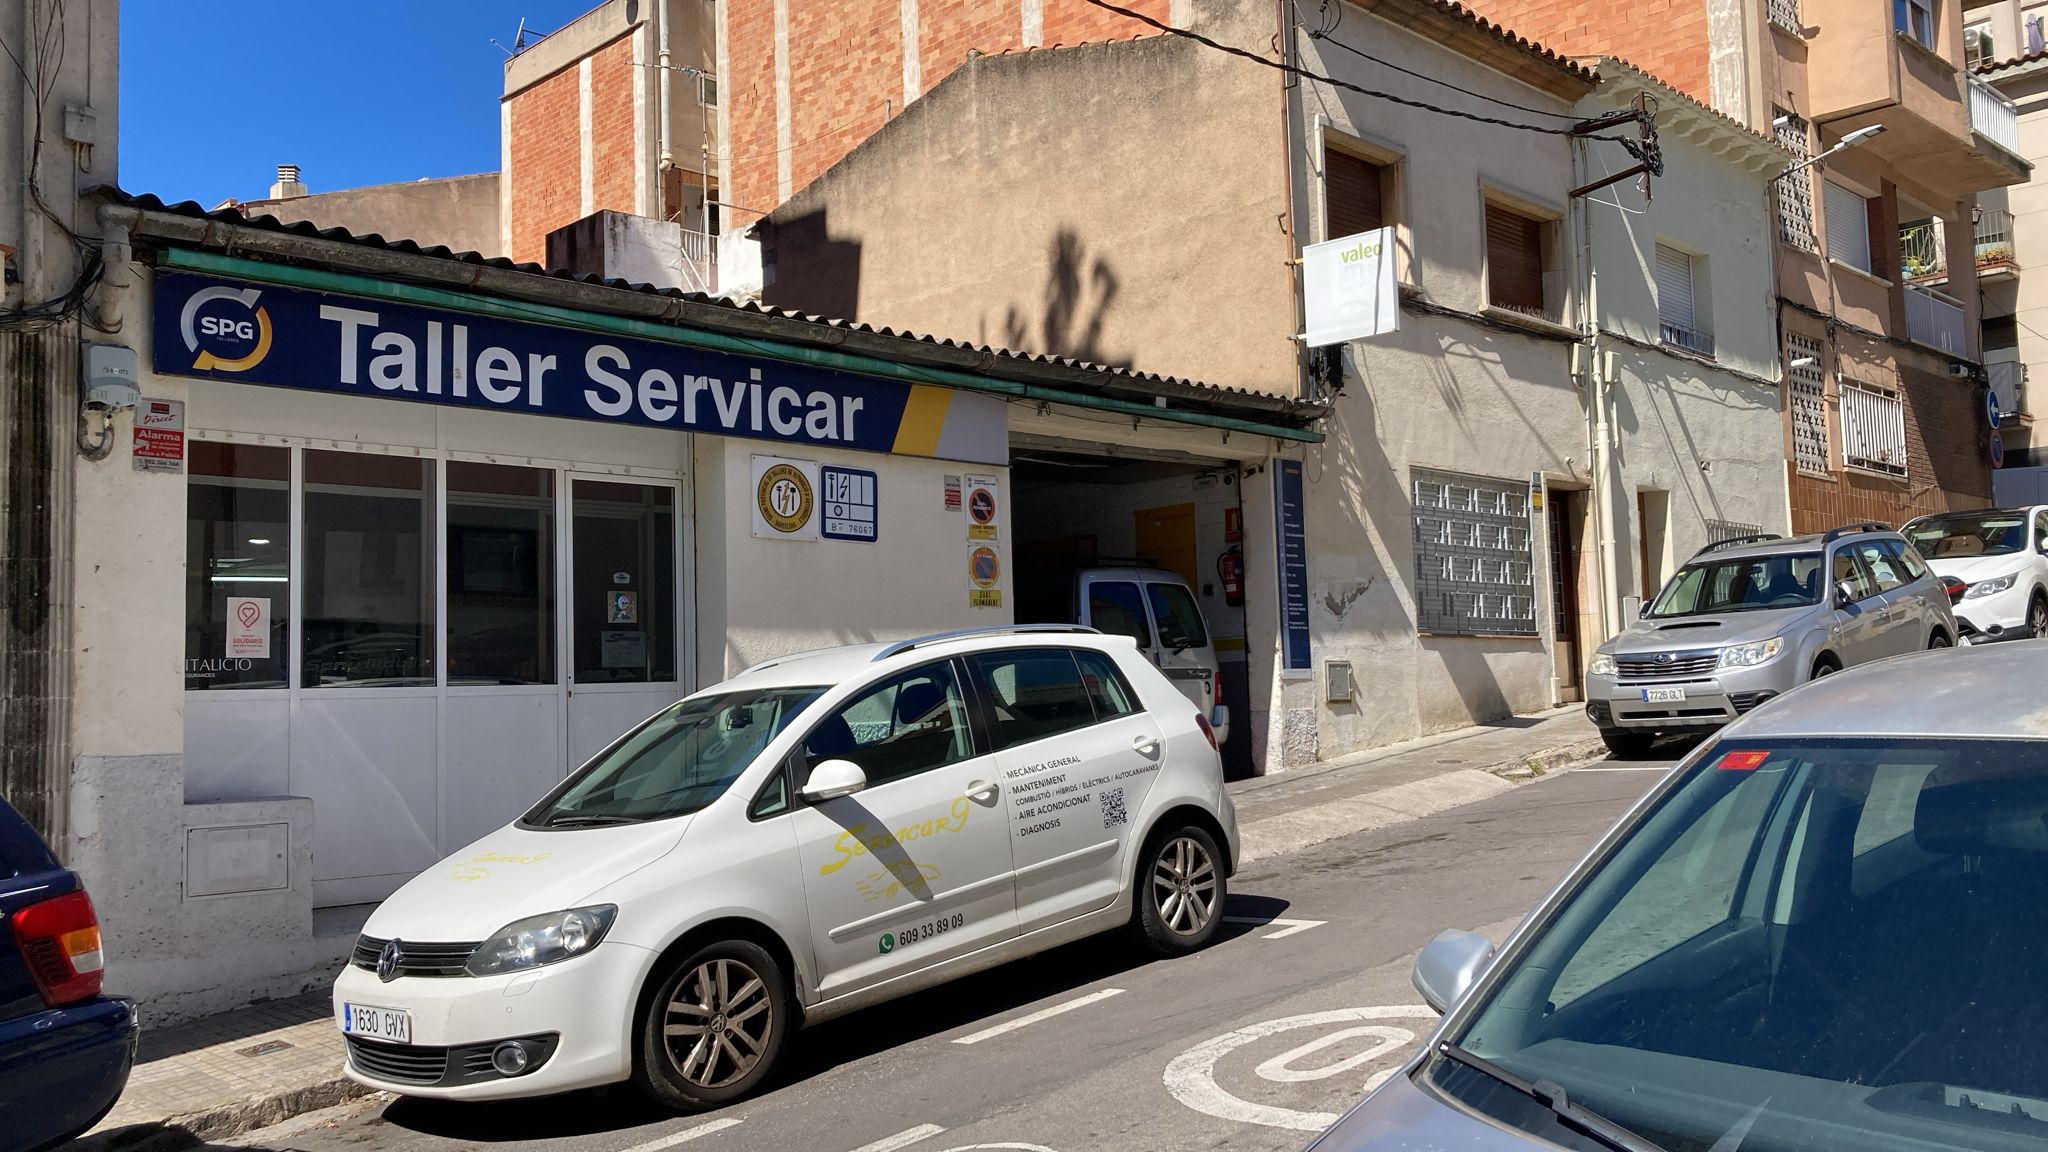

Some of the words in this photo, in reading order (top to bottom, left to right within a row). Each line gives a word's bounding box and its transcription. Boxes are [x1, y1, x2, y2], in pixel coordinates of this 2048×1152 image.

[1341, 242, 1383, 264] valeo
[201, 316, 253, 340] SPG
[319, 304, 557, 408] Taller
[584, 344, 864, 443] Servicar
[138, 429, 181, 441] Alarma
[1649, 690, 1668, 701] 7726
[1006, 763, 1047, 779] MECÀNICA
[1047, 755, 1082, 769] GENERAL
[1114, 763, 1159, 781] AUTOCARAVANES
[1011, 774, 1067, 795] MANTENIMENT
[1018, 808, 1036, 820] AIRE
[1037, 793, 1091, 815] ACONDICIONAT
[1020, 818, 1061, 837] DIAGNOSIS
[899, 929, 919, 946] 609
[921, 924, 934, 940] 33
[936, 918, 949, 934] 89
[951, 913, 964, 928] 09
[353, 1007, 379, 1033] 1630
[385, 1012, 406, 1039] GVX
